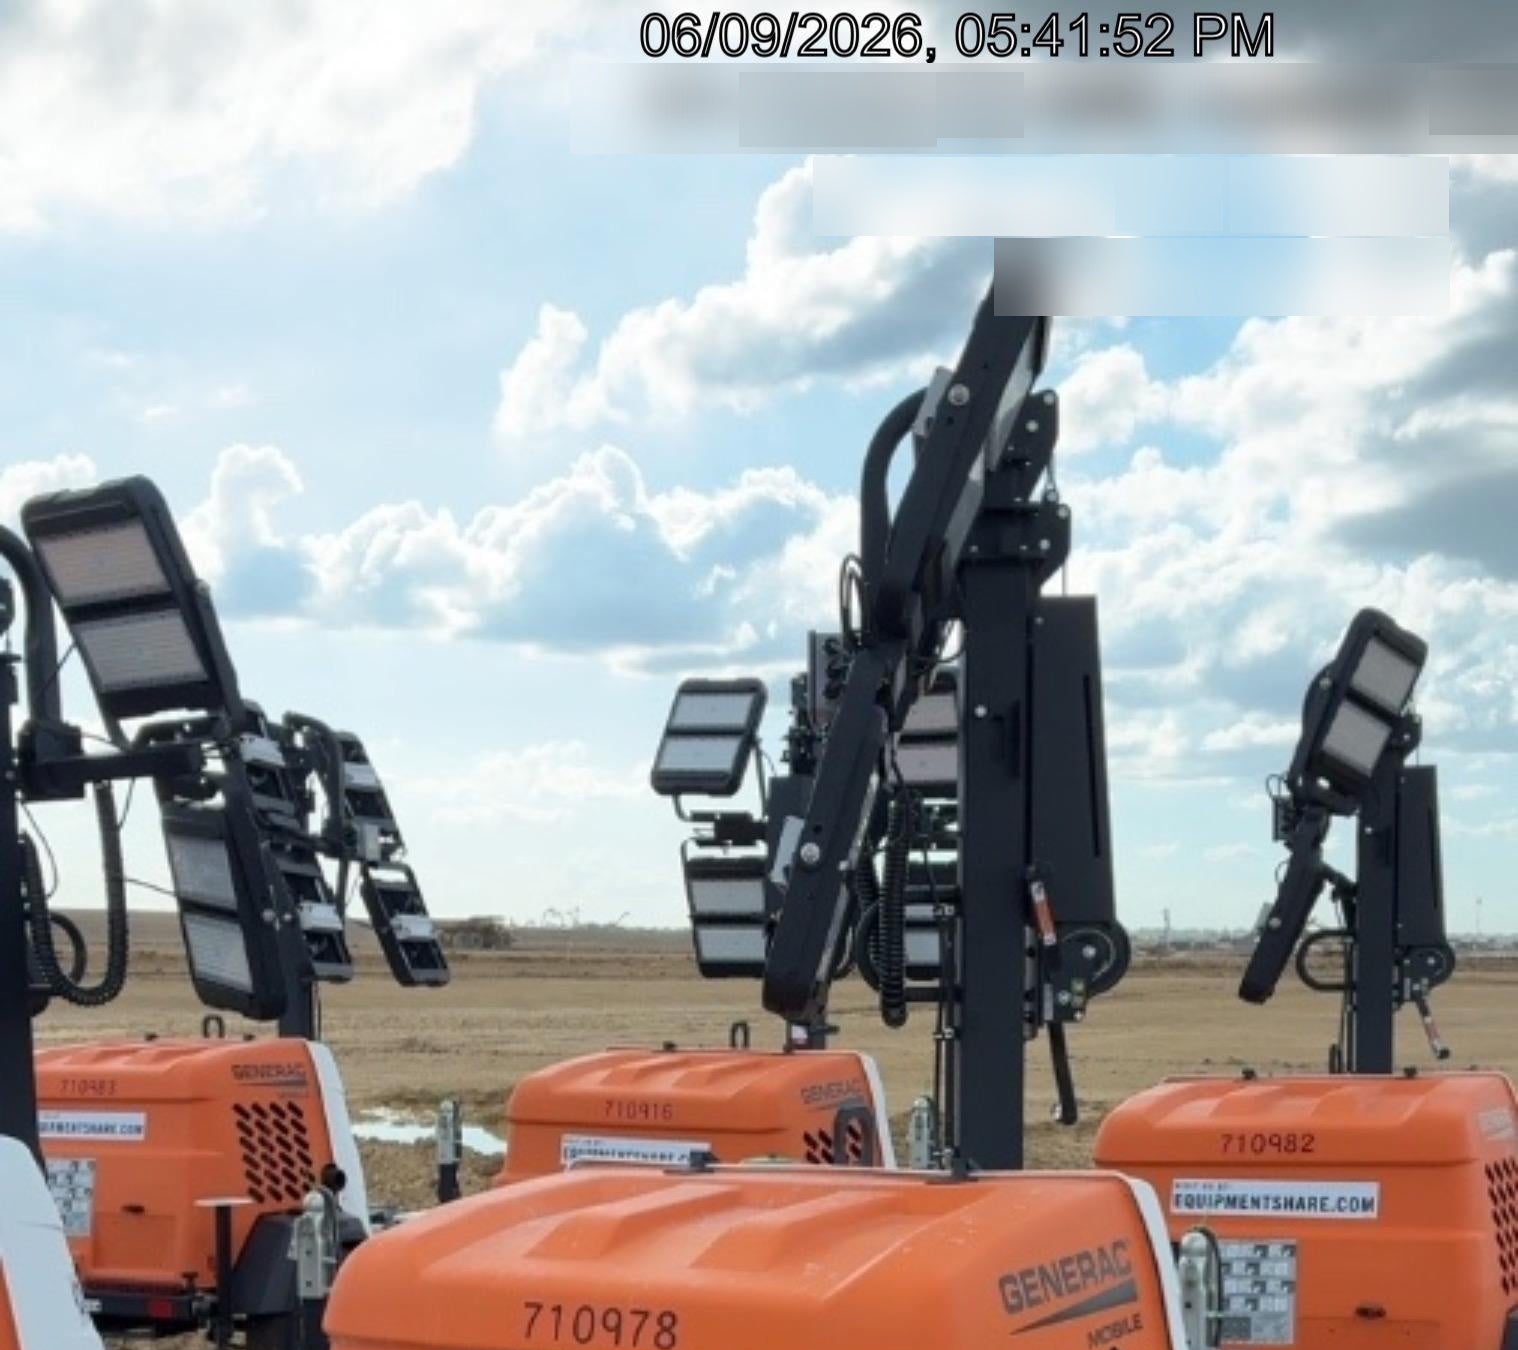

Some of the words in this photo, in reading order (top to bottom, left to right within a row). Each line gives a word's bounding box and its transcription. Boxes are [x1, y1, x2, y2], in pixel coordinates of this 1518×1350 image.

[1220, 1134, 1315, 1154] 710982
[1174, 1193, 1375, 1213] EQUIPMENTSHARE.COM
[999, 1239, 1132, 1315] GENERAC
[524, 1302, 678, 1350] 710978
[1087, 1312, 1144, 1349] MOBILE
